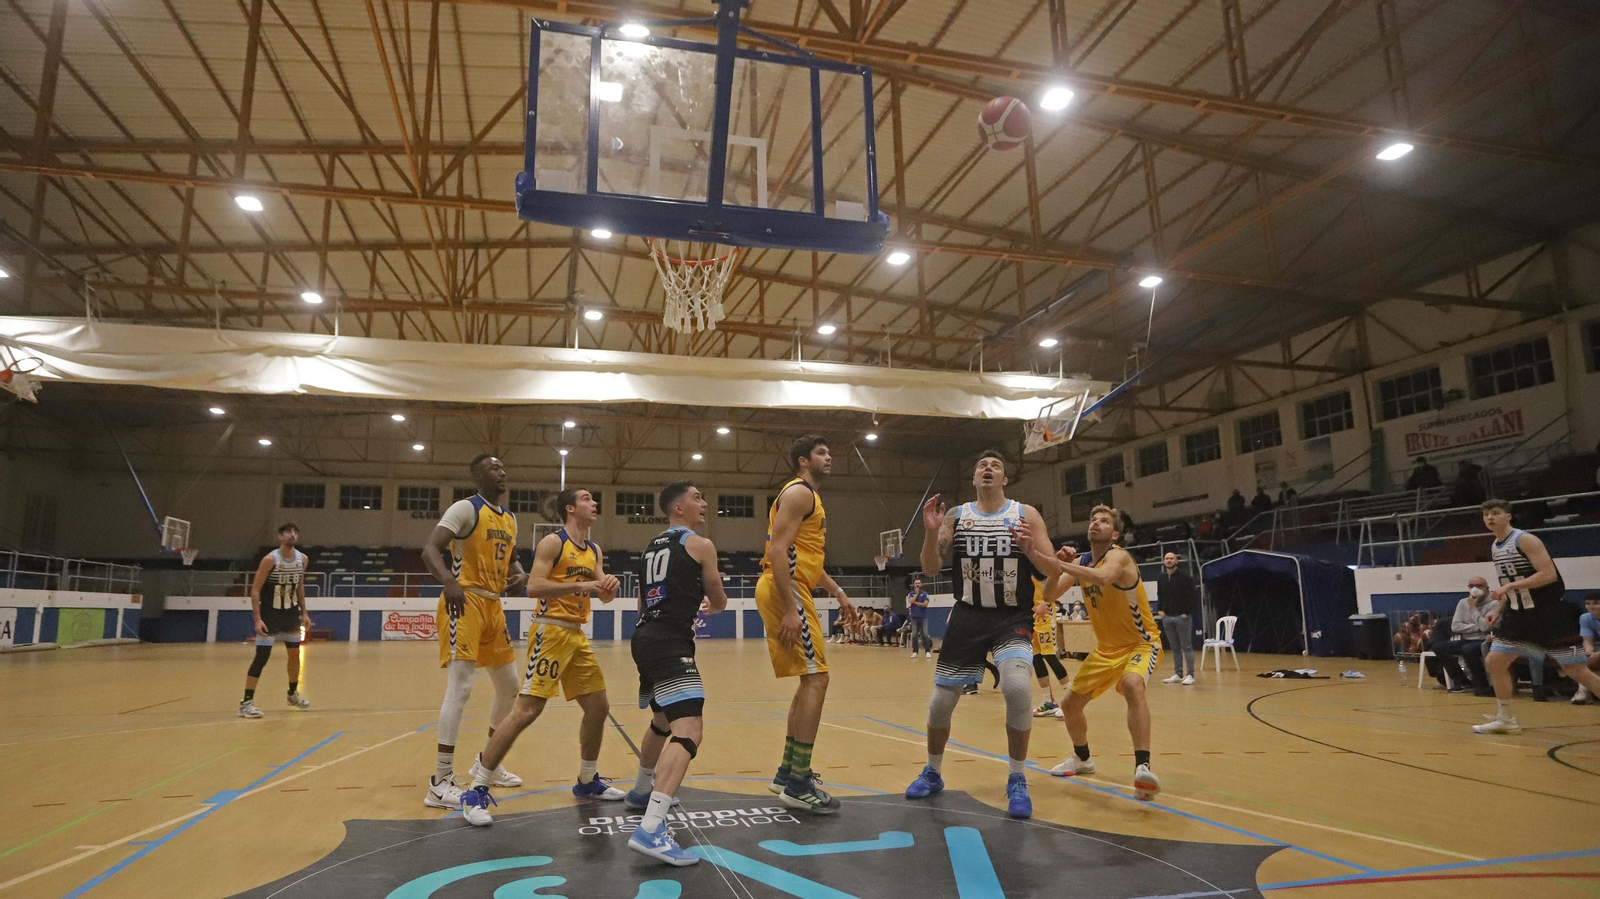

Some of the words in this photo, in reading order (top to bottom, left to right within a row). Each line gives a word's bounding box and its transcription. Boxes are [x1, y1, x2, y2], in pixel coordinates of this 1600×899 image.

[628, 516, 671, 525] BALONC
[495, 542, 507, 560] 15
[645, 548, 671, 585] 10
[0, 620, 11, 639] A
[1039, 632, 1052, 644] 82
[1131, 653, 1142, 664] 4
[536, 658, 560, 680] 00
[579, 814, 801, 836] baloncsto
